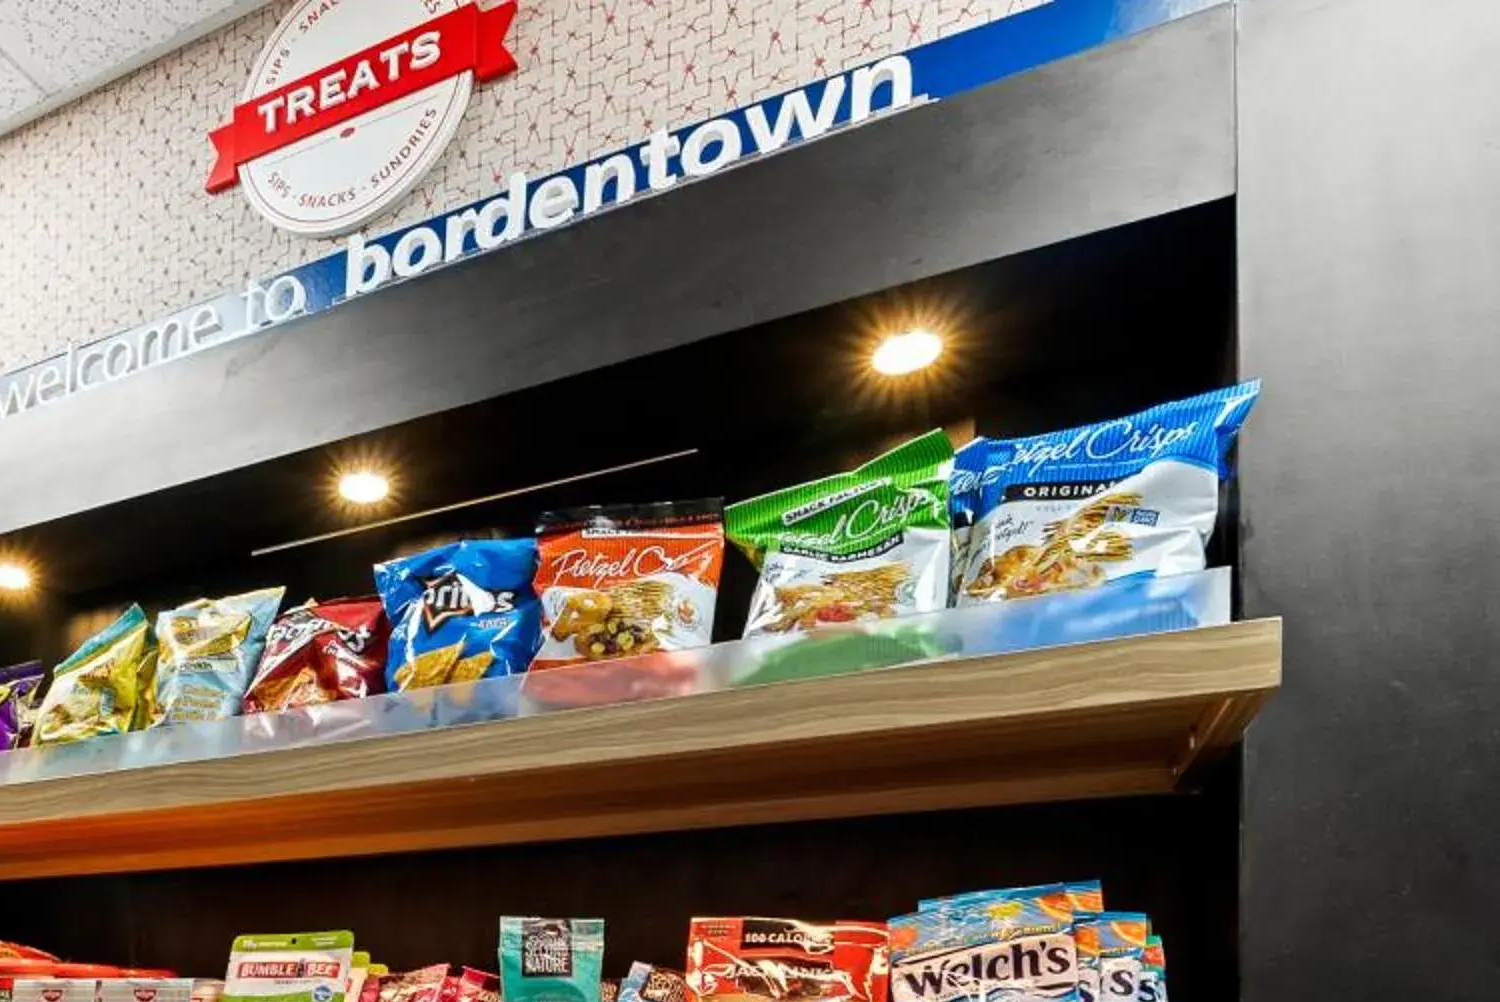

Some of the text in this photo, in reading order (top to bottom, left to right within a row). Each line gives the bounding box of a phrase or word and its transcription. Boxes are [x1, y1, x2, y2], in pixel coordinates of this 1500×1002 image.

[258, 31, 442, 133] TREATS
[242, 274, 306, 332] to
[344, 53, 916, 299] bordentown
[266, 107, 438, 210] SIPS SNACKS SUNDRIES
[1088, 418, 1201, 459] Crisps
[240, 962, 296, 977] BUMBLE
[904, 941, 1071, 997] Welch's
